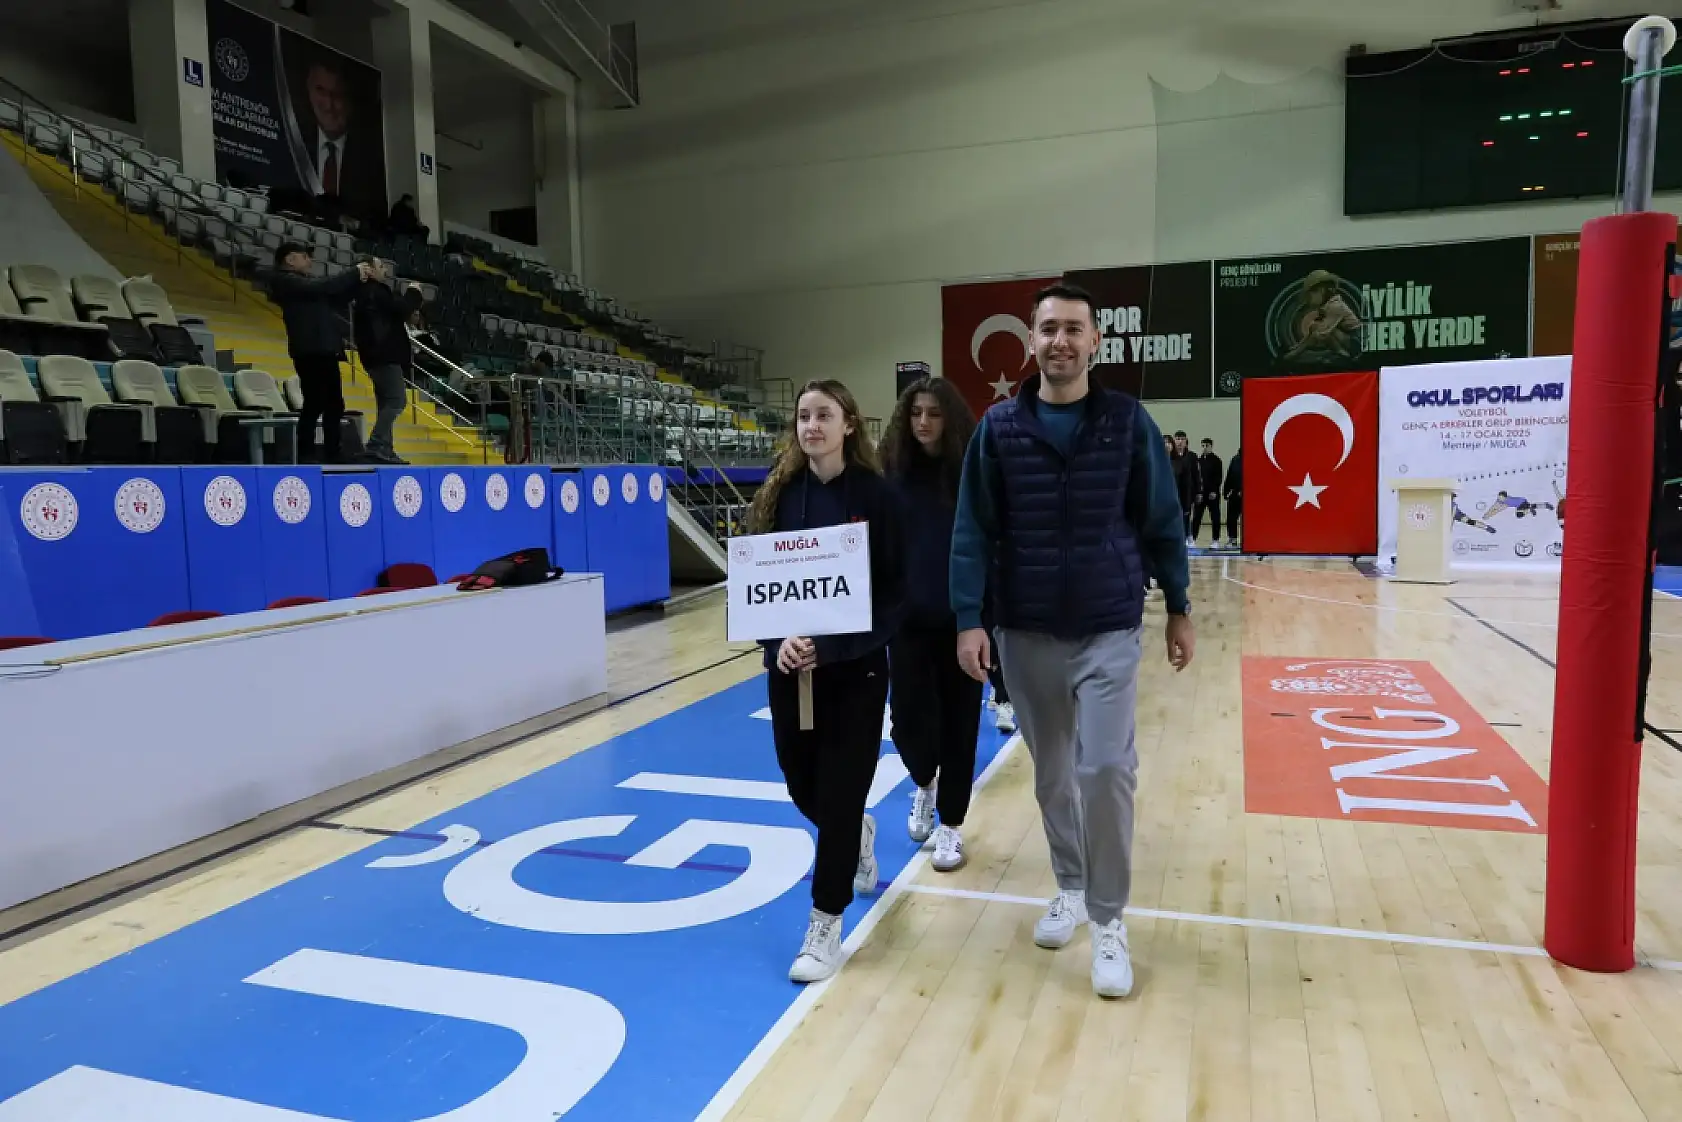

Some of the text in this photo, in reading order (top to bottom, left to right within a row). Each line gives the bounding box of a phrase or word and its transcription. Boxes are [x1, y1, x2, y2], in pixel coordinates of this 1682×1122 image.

[1361, 280, 1432, 319] İYİLİK
[1361, 315, 1486, 352] HER YERDE
[1129, 333, 1192, 363] YERDE
[1407, 382, 1565, 408] OKUL SPORLARI
[1402, 415, 1568, 432] GENÇ A ERKEKLER GRUP BİRİNCİLİĞ
[1457, 407, 1508, 418] VOLEYBOL
[1440, 432, 1451, 440] 14
[1460, 431, 1471, 439] 17
[1473, 430, 1505, 439] OCAK
[1506, 429, 1531, 438] 2025
[1490, 438, 1527, 449] MUĞLA
[774, 535, 819, 552] MUĞLA
[747, 575, 852, 606] ISPARTA
[1308, 705, 1539, 827] ING
